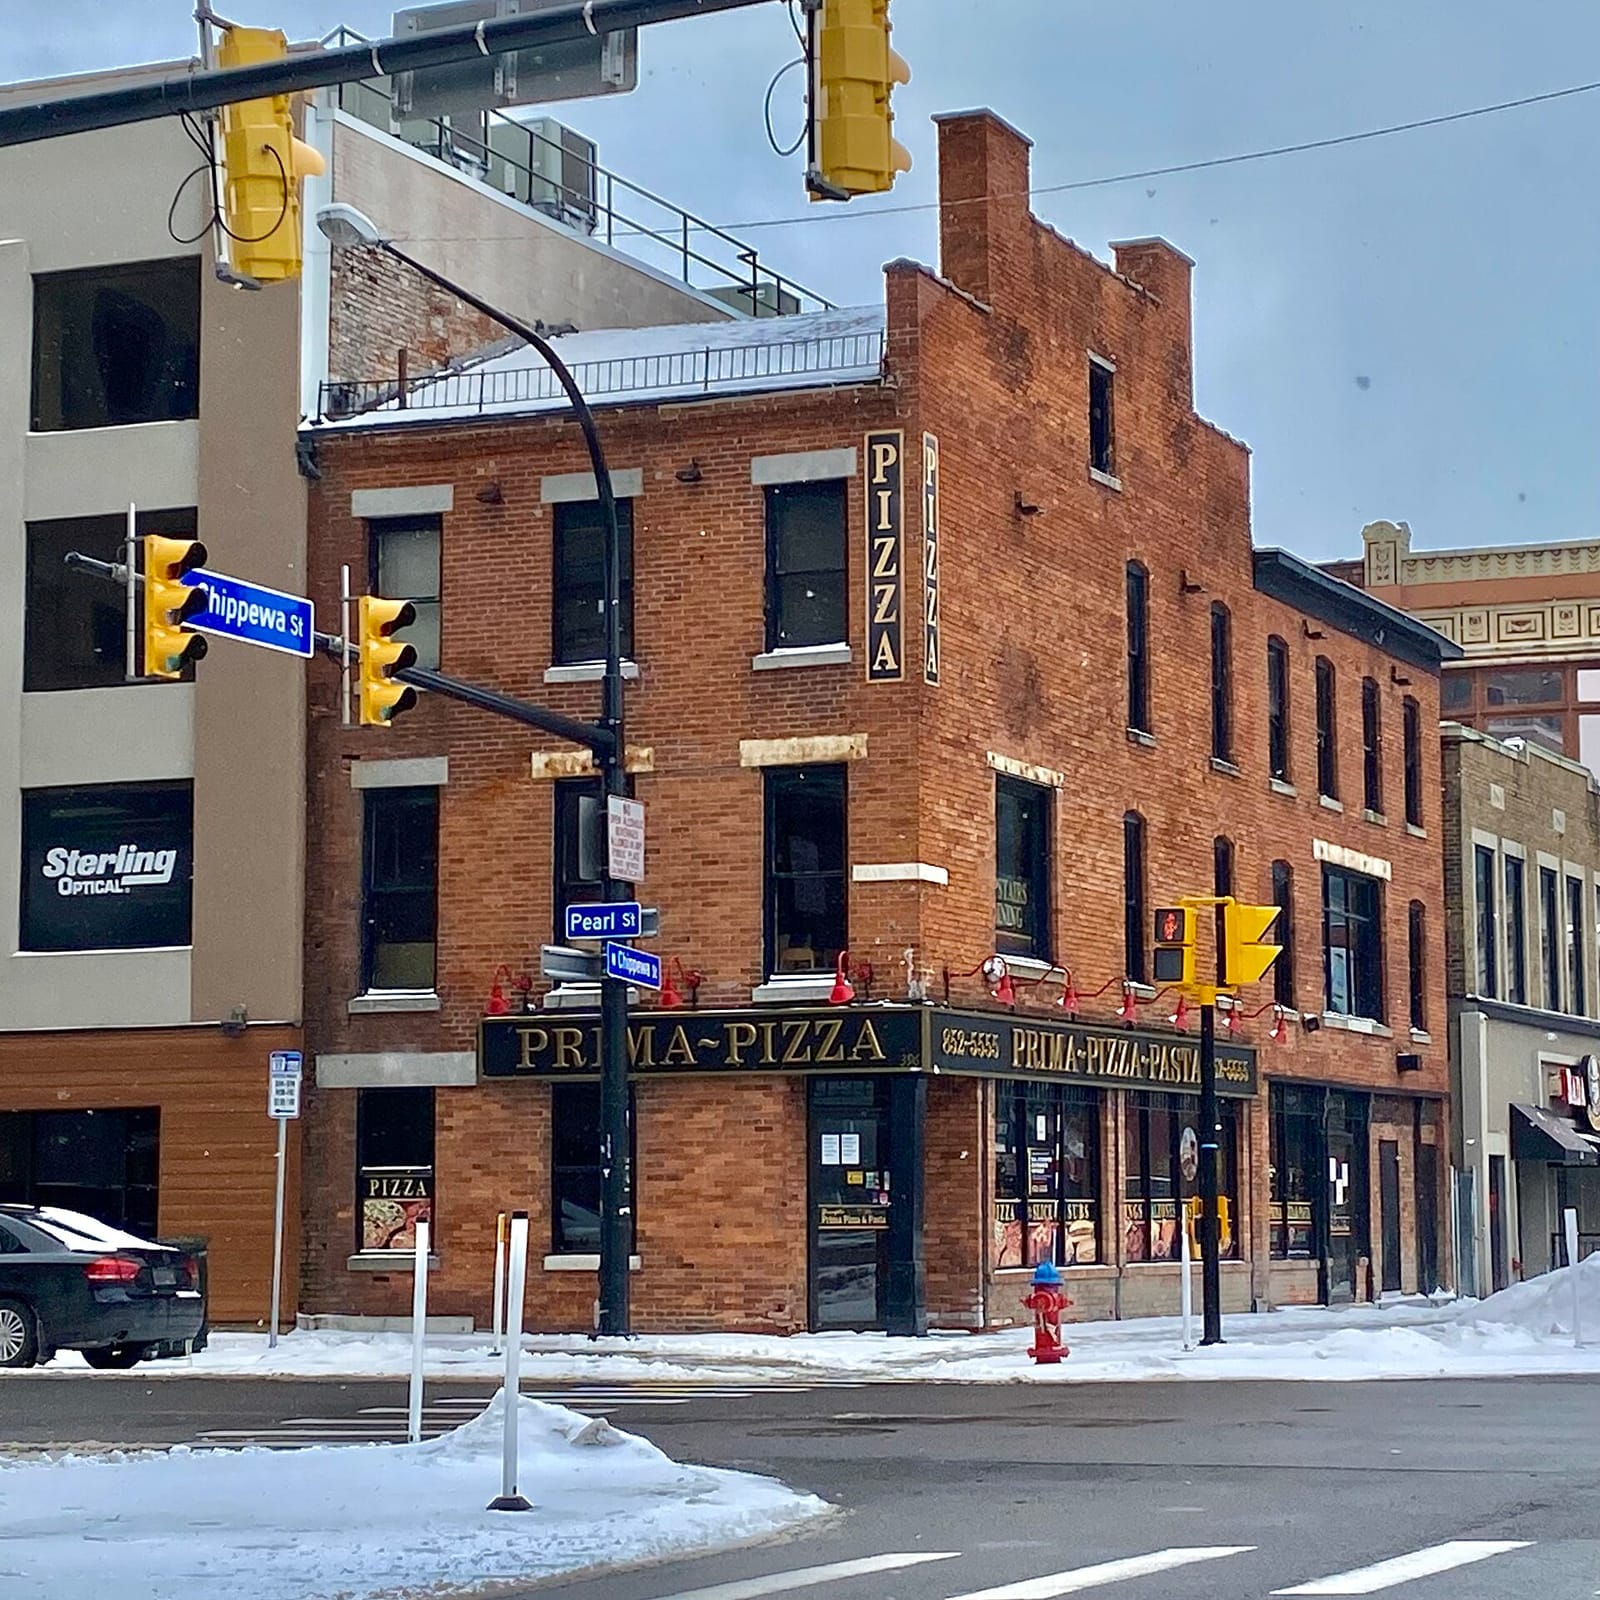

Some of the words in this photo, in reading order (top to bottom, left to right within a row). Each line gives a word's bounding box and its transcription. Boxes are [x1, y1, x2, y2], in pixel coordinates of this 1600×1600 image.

[871, 443, 899, 671] PIZZA
[925, 446, 938, 674] PIZZA
[198, 582, 287, 633] hippewa
[290, 614, 304, 637] St
[42, 844, 177, 884] Sterling
[570, 911, 616, 932] Pearl
[622, 911, 636, 928] St
[617, 950, 651, 978] Chippewa
[942, 1027, 1000, 1060] 852-5555
[368, 1178, 428, 1197] PIZZA
[1066, 1203, 1090, 1220] SUBS
